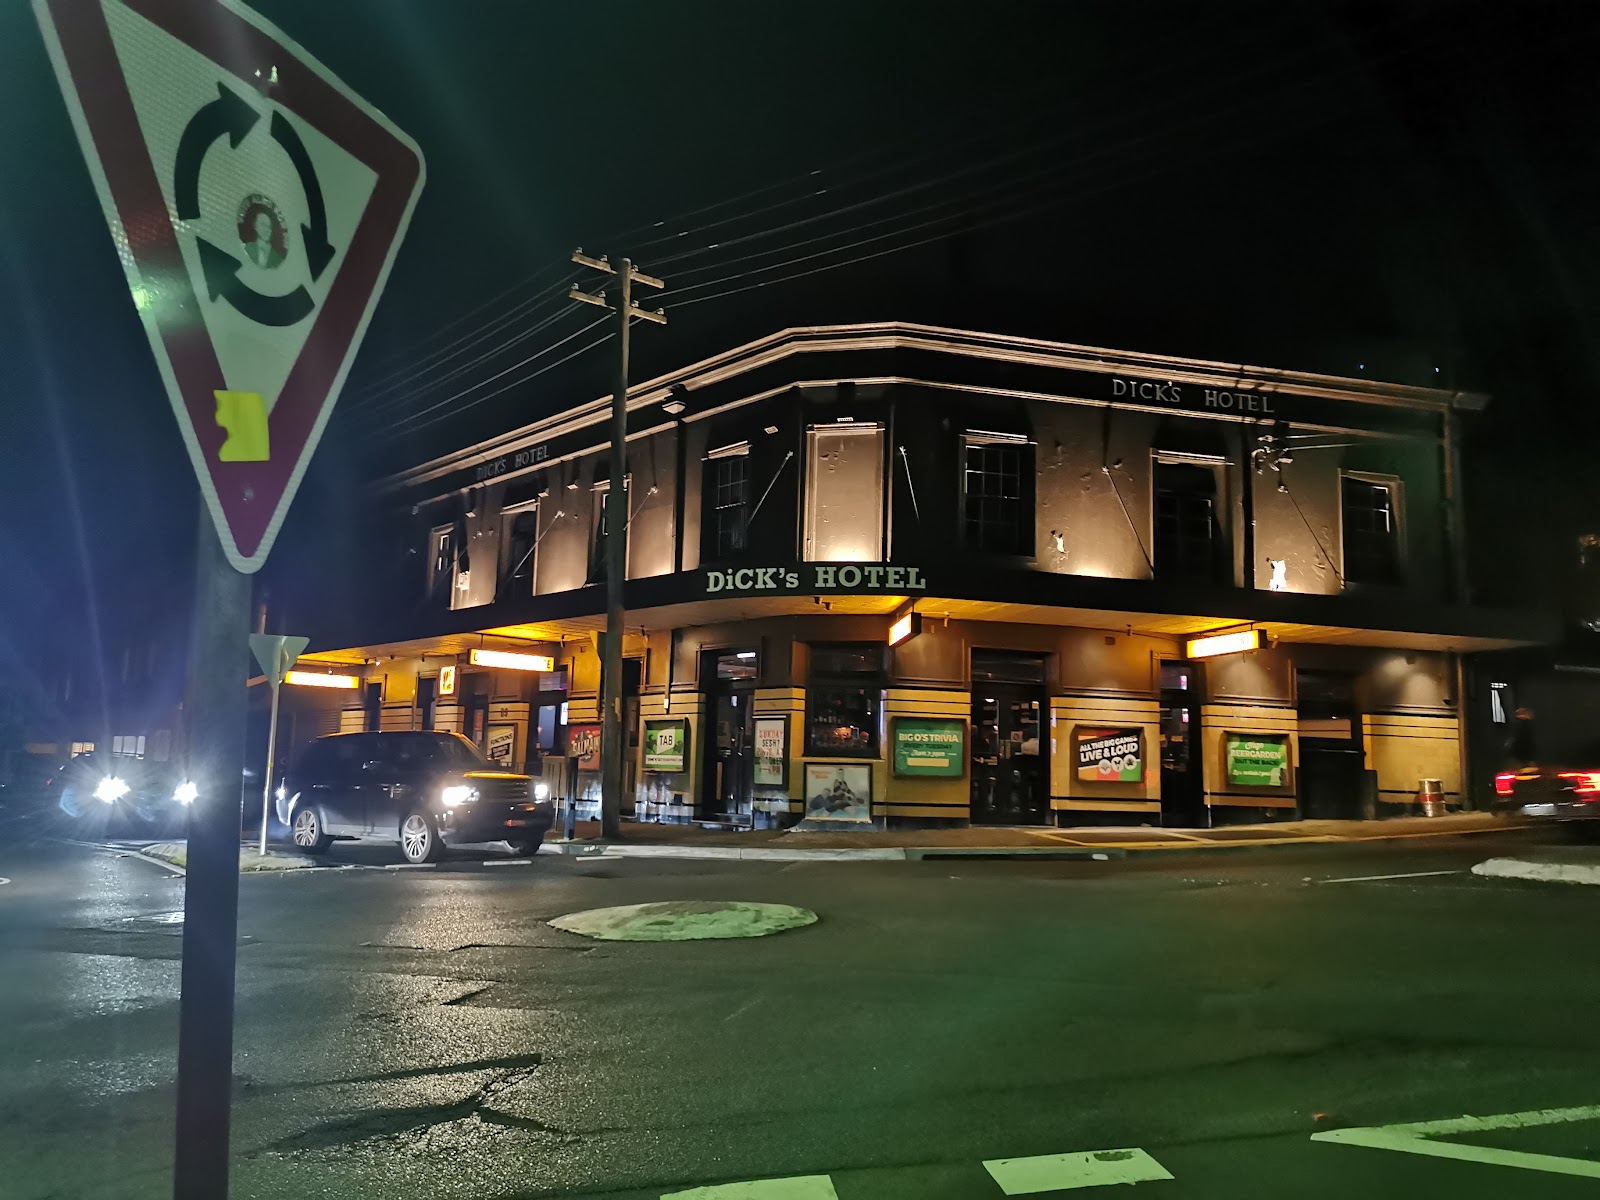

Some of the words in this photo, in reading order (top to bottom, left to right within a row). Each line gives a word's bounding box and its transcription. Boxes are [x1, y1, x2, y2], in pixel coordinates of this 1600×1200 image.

[1112, 378, 1182, 402] DICK'S
[1204, 389, 1275, 413] HOTEL
[476, 457, 507, 480] DICK'S
[515, 445, 550, 467] HOTEL
[814, 565, 926, 589] HOTEL
[659, 735, 673, 746] TAB
[759, 729, 783, 739] SUNDAY
[898, 733, 914, 741] BIG
[929, 734, 960, 743] TRIVIA
[1080, 744, 1092, 753] ALL
[1090, 741, 1104, 750] THE
[1104, 739, 1115, 748] BIG
[1115, 736, 1138, 746] GAMES
[1080, 749, 1103, 763] LIVE
[1103, 747, 1110, 758] &
[1110, 742, 1138, 756] LOUD
